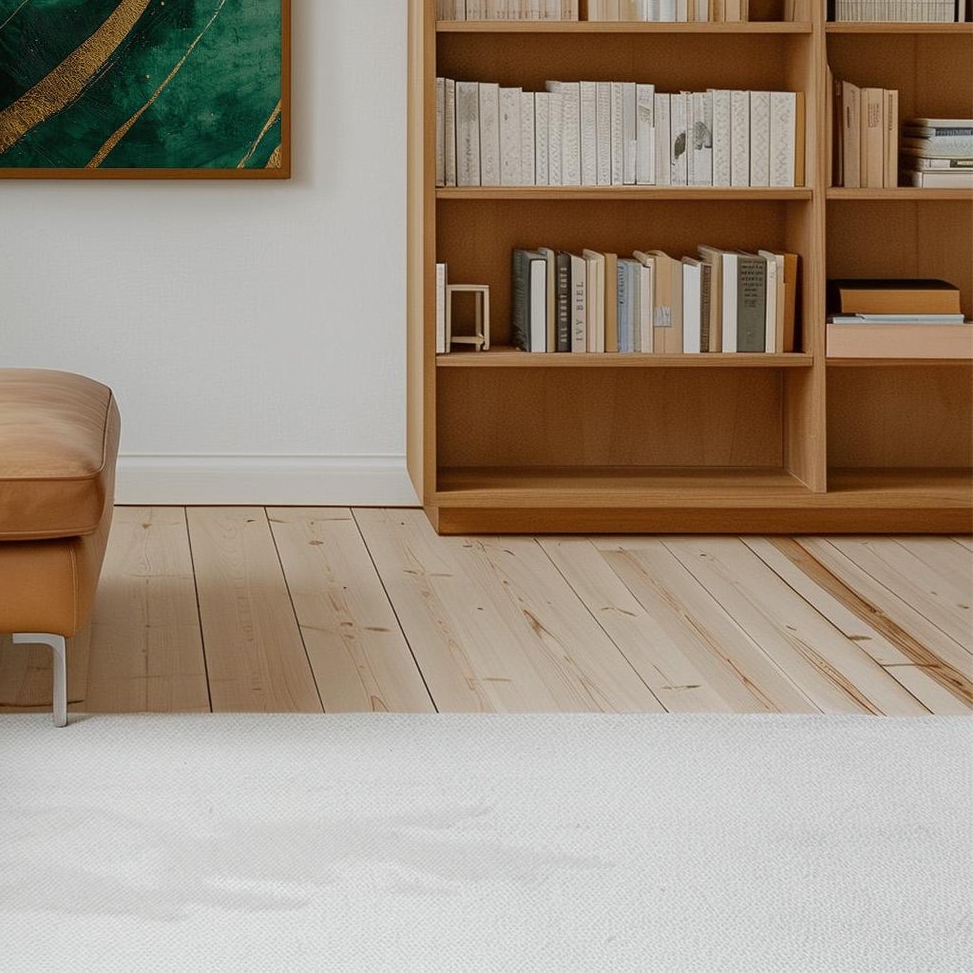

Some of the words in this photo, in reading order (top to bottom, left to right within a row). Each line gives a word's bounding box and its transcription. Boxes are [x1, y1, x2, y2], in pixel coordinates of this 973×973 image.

[575, 281, 584, 311] BIEL
[560, 326, 568, 343] ALL
[575, 318, 584, 342] IVY
